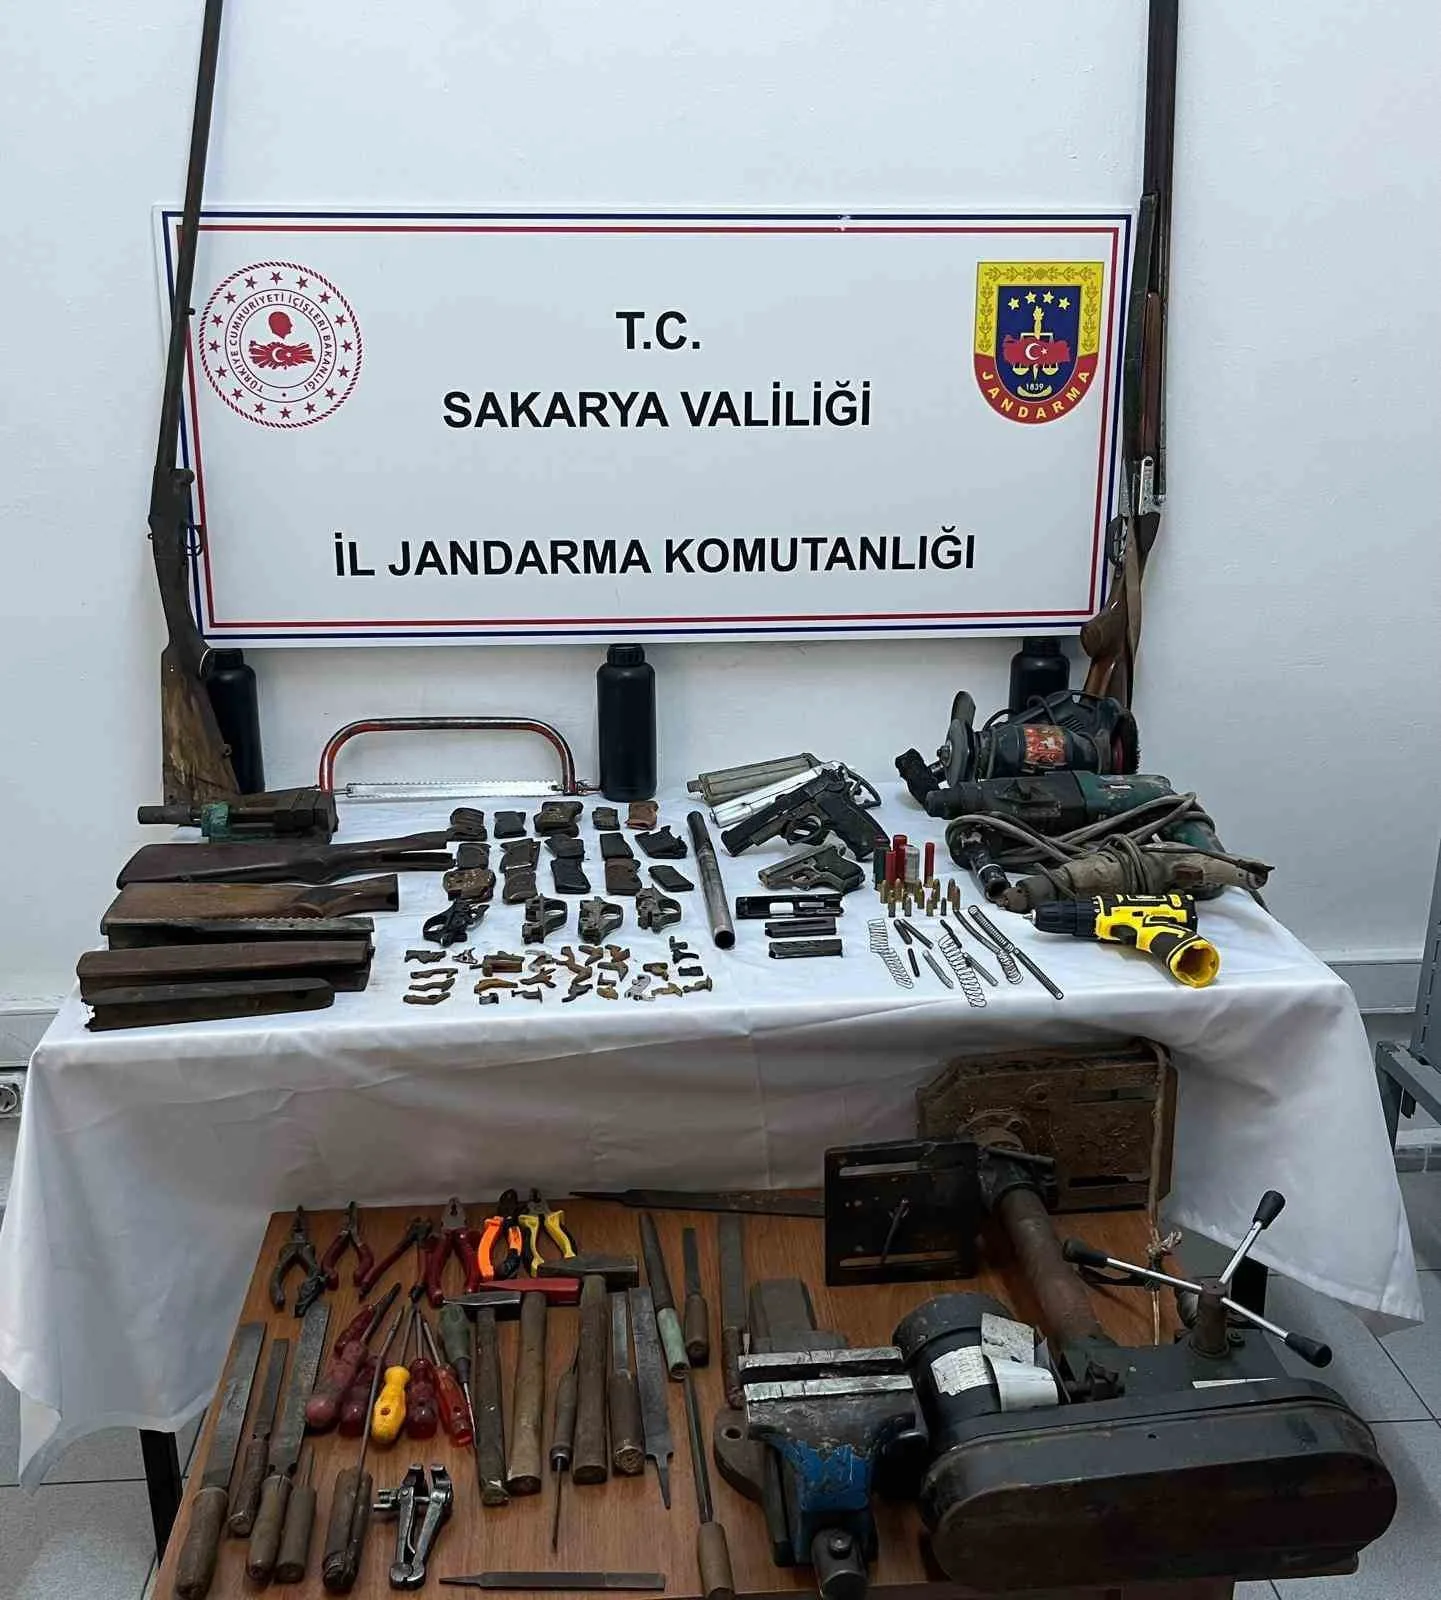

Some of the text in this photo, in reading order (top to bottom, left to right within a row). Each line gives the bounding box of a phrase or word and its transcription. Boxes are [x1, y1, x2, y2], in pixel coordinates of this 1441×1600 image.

[229, 292, 333, 393] TÜRKİYE CUMHURİYETİ İÇİŞLERİ BAKANLIĞI
[615, 311, 701, 350] T.C.
[443, 380, 871, 429] SAKARYA VALİLİĞİ
[982, 371, 1090, 419] JANDARMA
[1025, 383, 1044, 391] 1839
[334, 525, 975, 577] İL JANDARMA KOMUTANLIĞI
